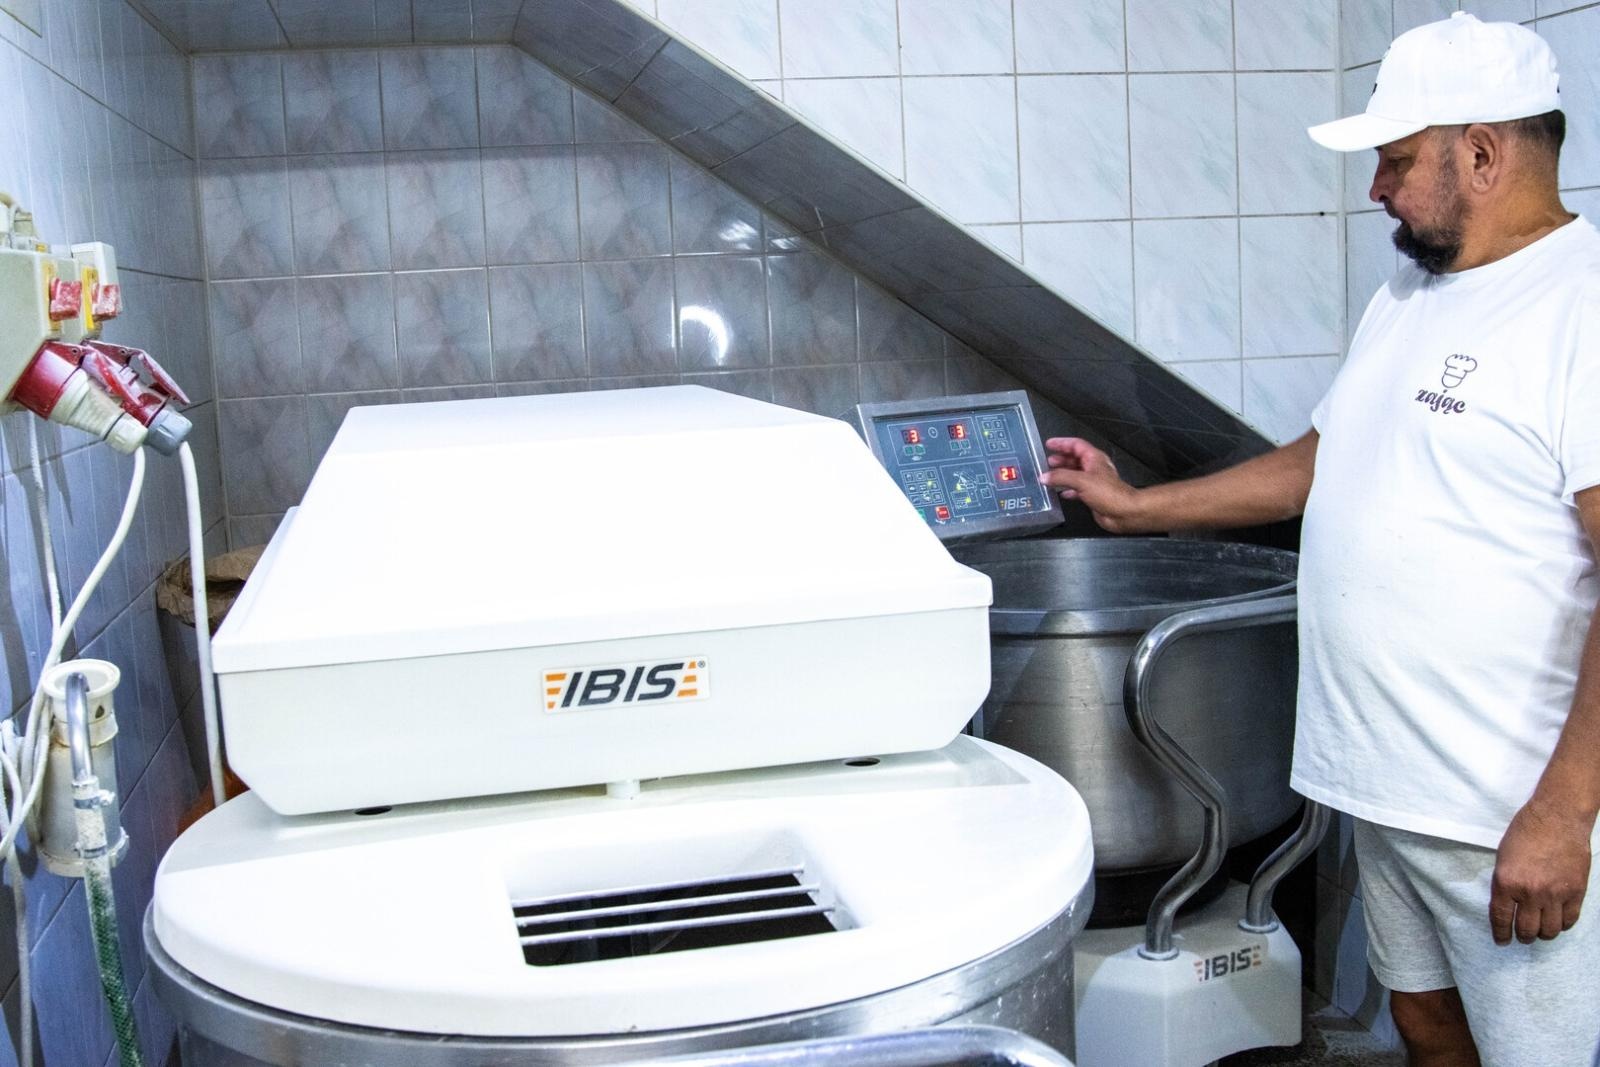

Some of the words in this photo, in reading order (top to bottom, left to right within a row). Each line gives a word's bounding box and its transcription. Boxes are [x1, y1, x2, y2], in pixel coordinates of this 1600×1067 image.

[1415, 389, 1466, 414] zając
[909, 429, 919, 443] 3
[955, 424, 965, 438] 3
[1001, 467, 1016, 481] 21
[1004, 497, 1028, 510] IBIS
[561, 662, 685, 708] IBIS
[1204, 947, 1252, 980] IBIS
